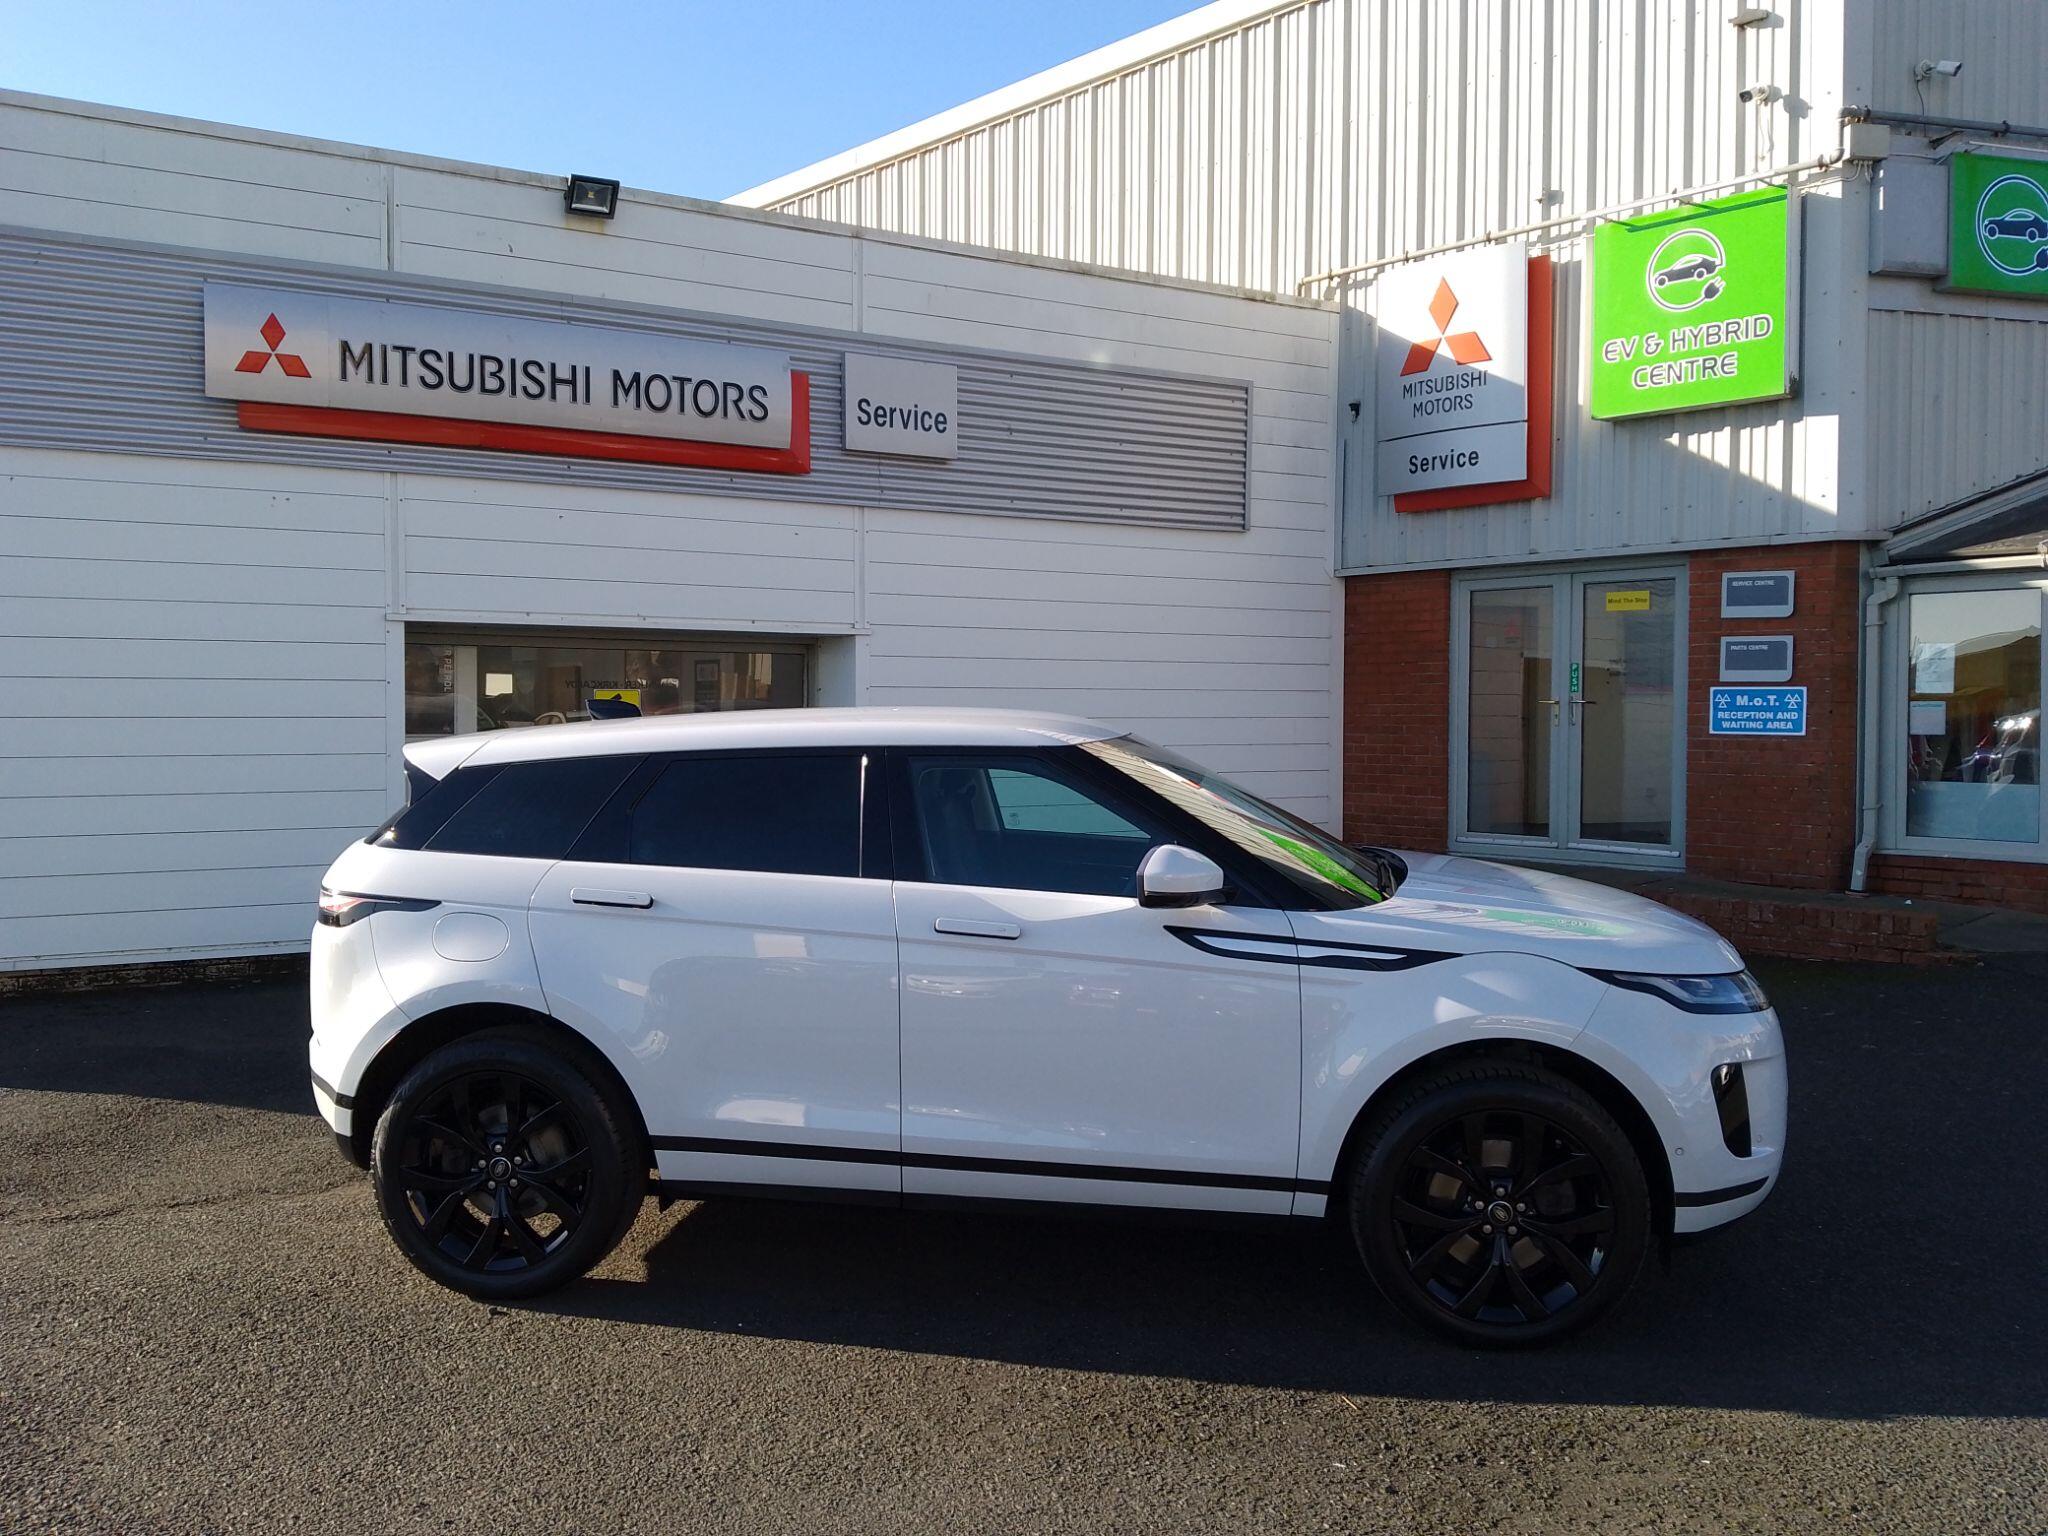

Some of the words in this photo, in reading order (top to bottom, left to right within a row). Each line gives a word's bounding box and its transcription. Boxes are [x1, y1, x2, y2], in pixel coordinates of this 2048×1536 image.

[1603, 336, 1637, 364] EV
[1644, 330, 1662, 357] &
[1669, 313, 1774, 354] HYBRID
[339, 339, 592, 405] MITSUBISHI
[611, 367, 770, 423] MOTORS
[1402, 369, 1488, 400] MITSUBISHI
[1632, 351, 1738, 390] CENTRE
[856, 398, 949, 435] Service
[1412, 393, 1474, 419] MOTORS
[1408, 448, 1480, 475] Service
[1717, 711, 1774, 720] RECEPTION
[1776, 711, 1799, 720] AND
[1721, 720, 1764, 729] WAITING
[1766, 721, 1793, 730] AREA
